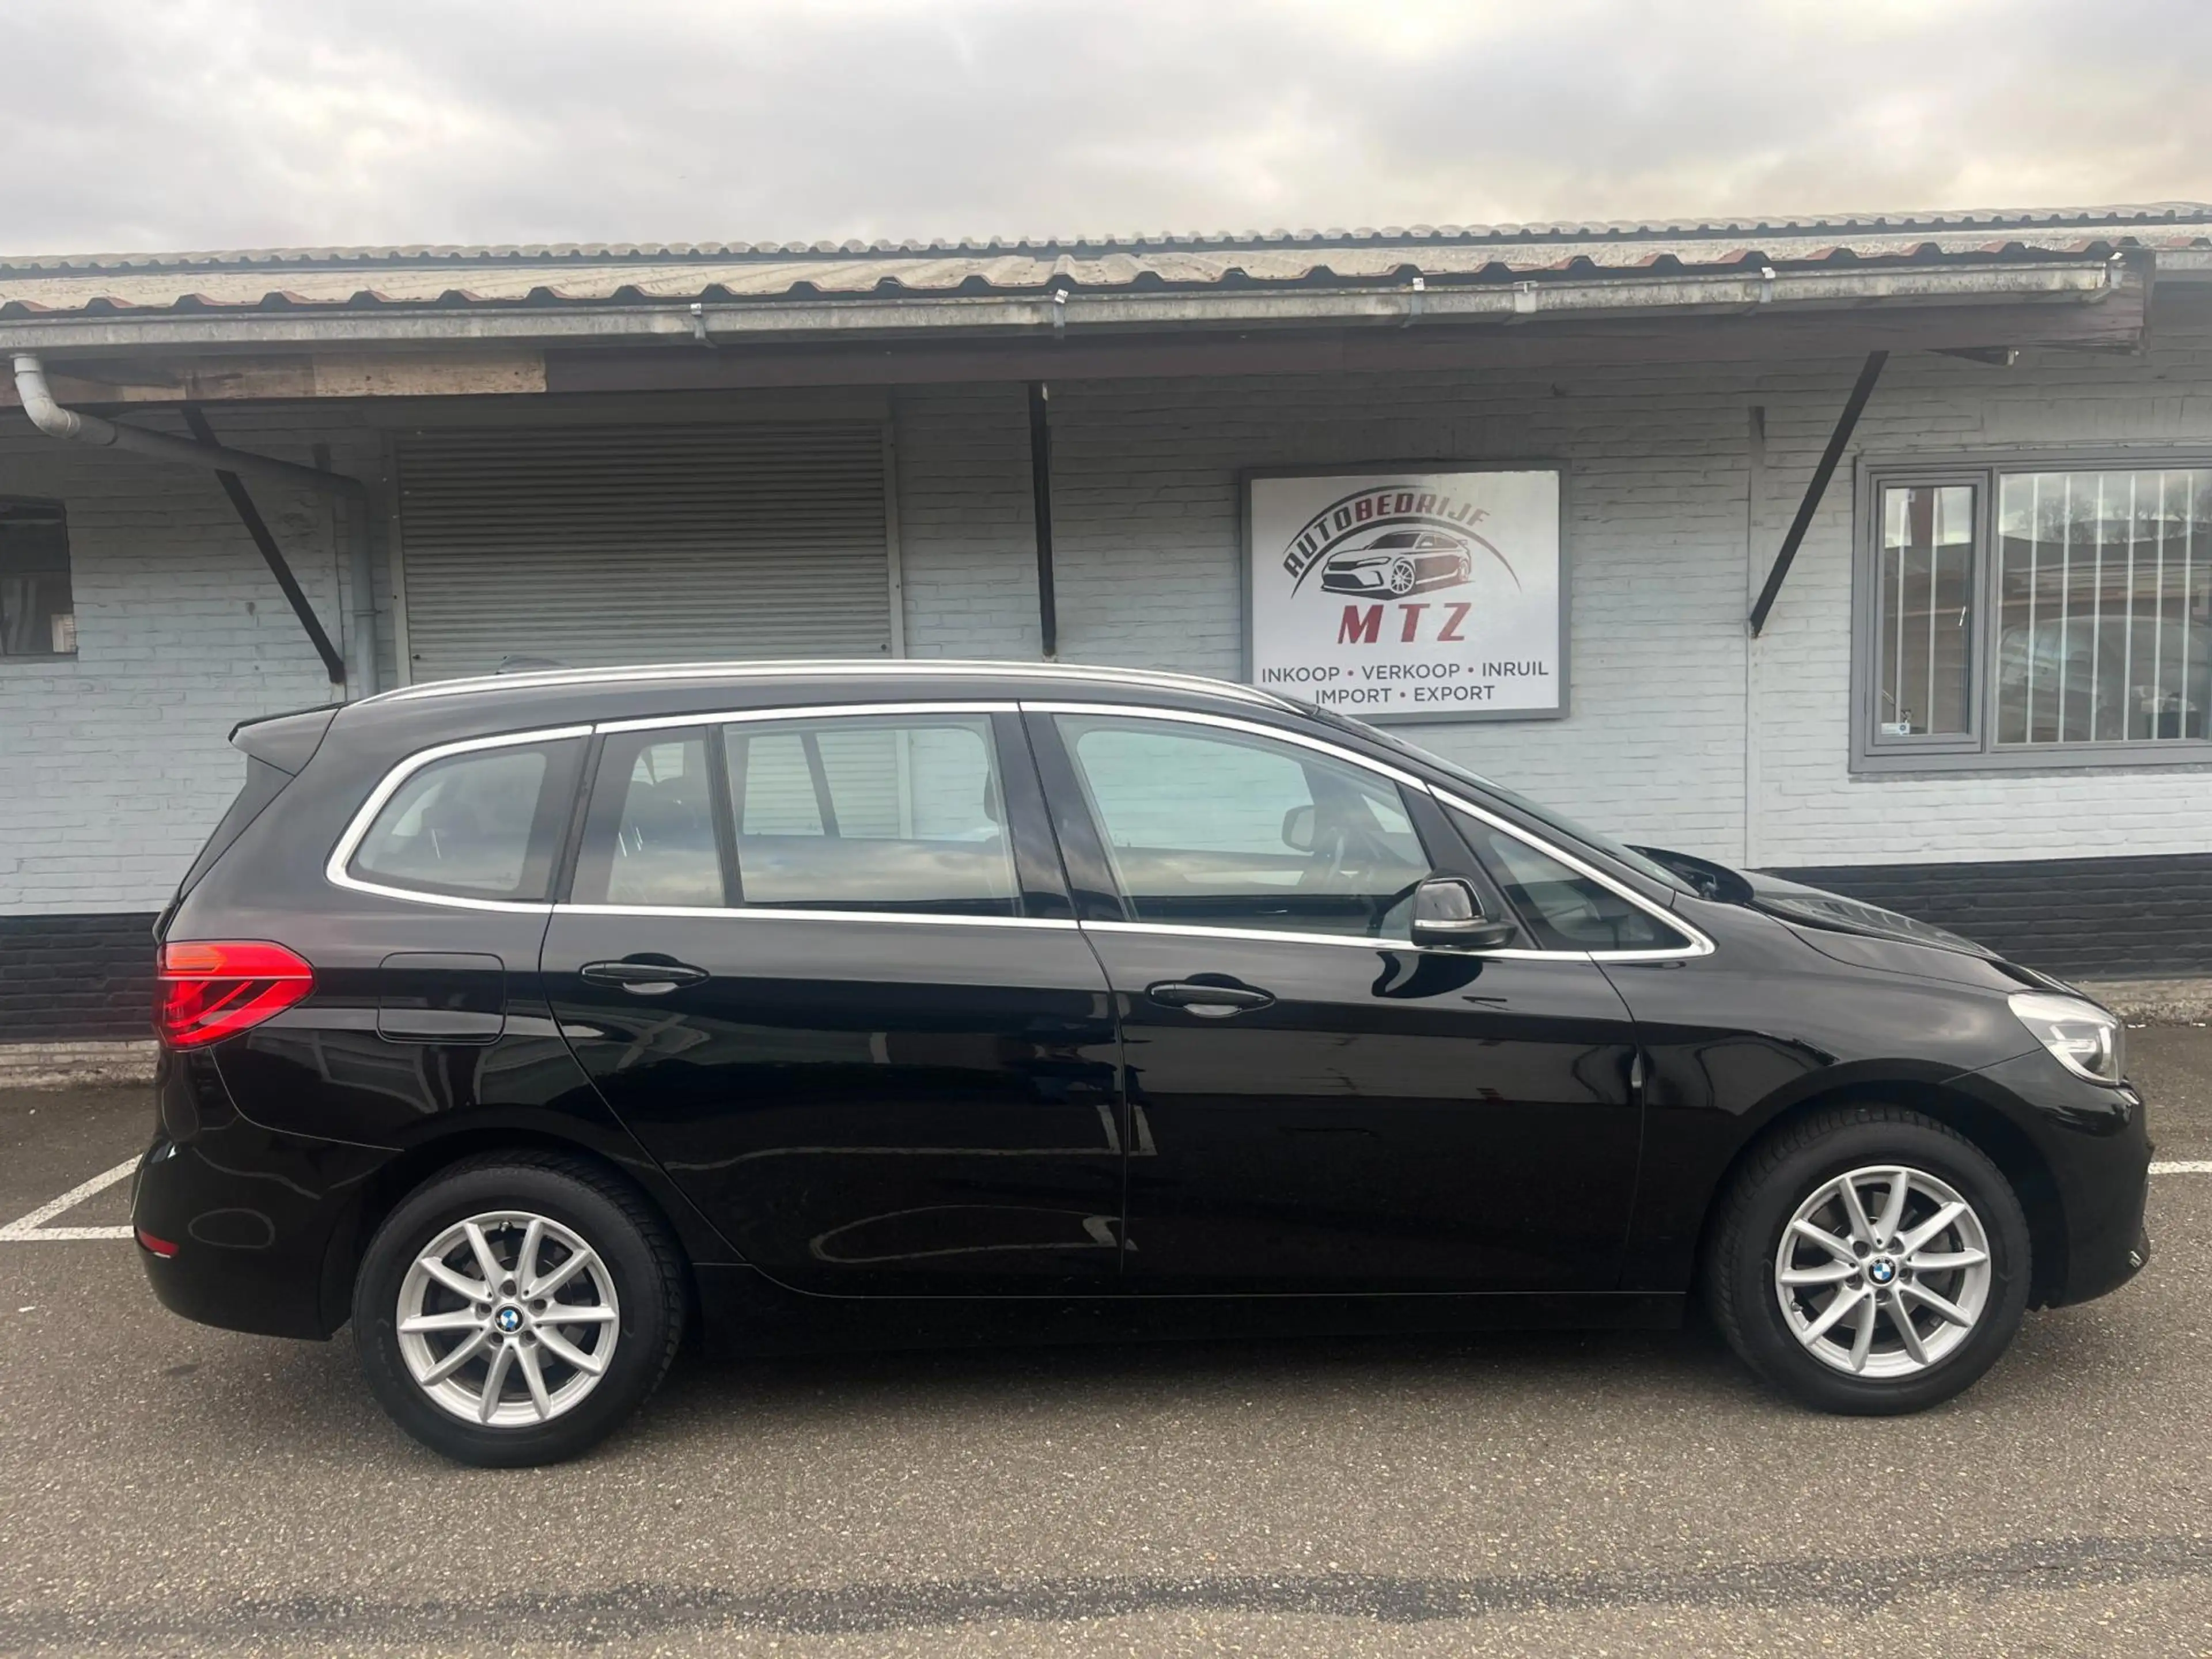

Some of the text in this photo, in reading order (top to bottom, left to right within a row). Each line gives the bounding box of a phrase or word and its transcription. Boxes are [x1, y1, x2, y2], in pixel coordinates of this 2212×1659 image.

[1283, 493, 1491, 578] AUTOBEDRIJF
[1336, 602, 1472, 645] MTZ
[1262, 661, 1550, 683] INKOOP VERKOOP INRUIL
[1315, 684, 1495, 704] IMPORT EXPORT
